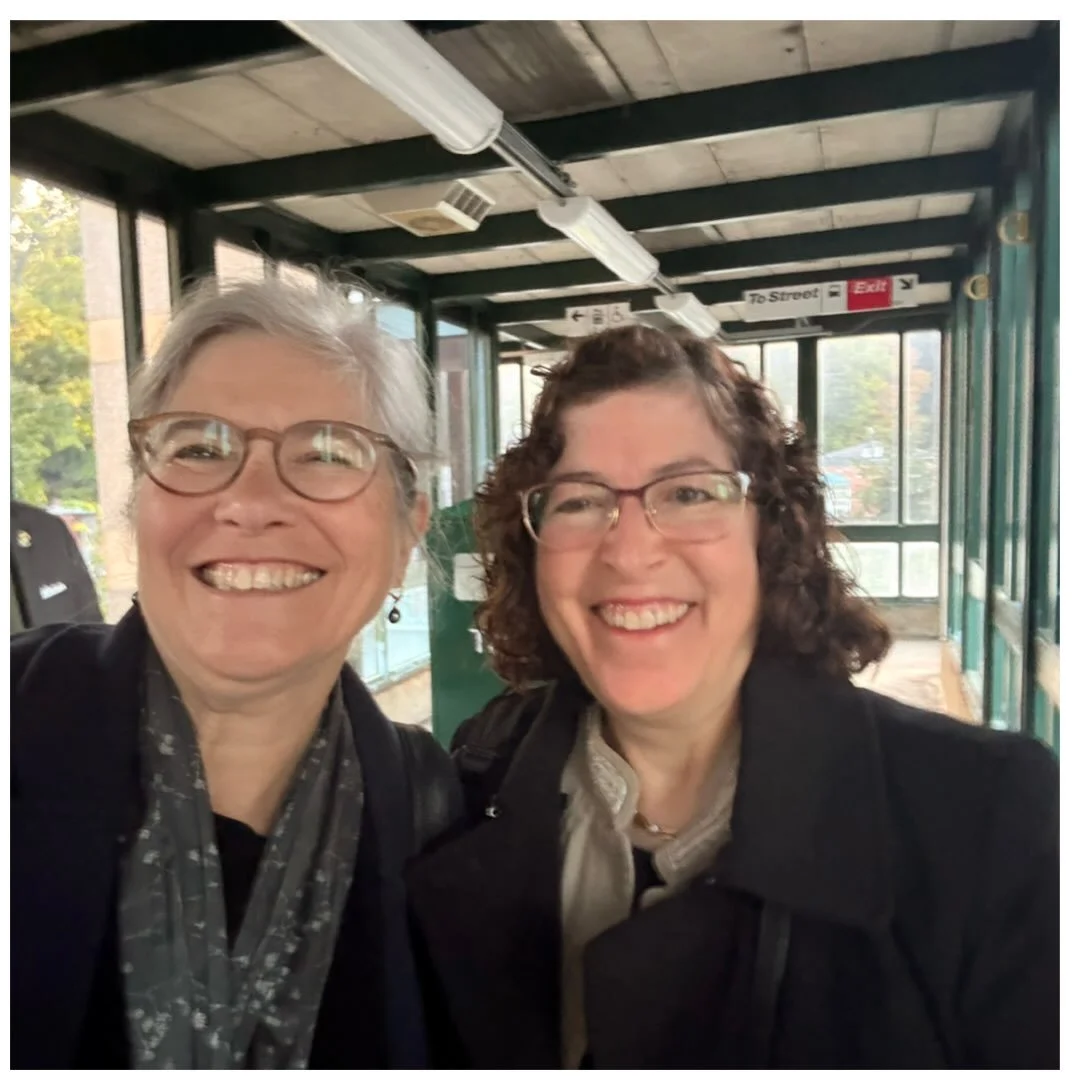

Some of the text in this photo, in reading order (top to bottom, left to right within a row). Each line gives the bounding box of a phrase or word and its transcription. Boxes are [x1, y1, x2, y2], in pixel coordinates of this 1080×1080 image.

[749, 286, 820, 306] To Street
[853, 279, 888, 295] Exit
